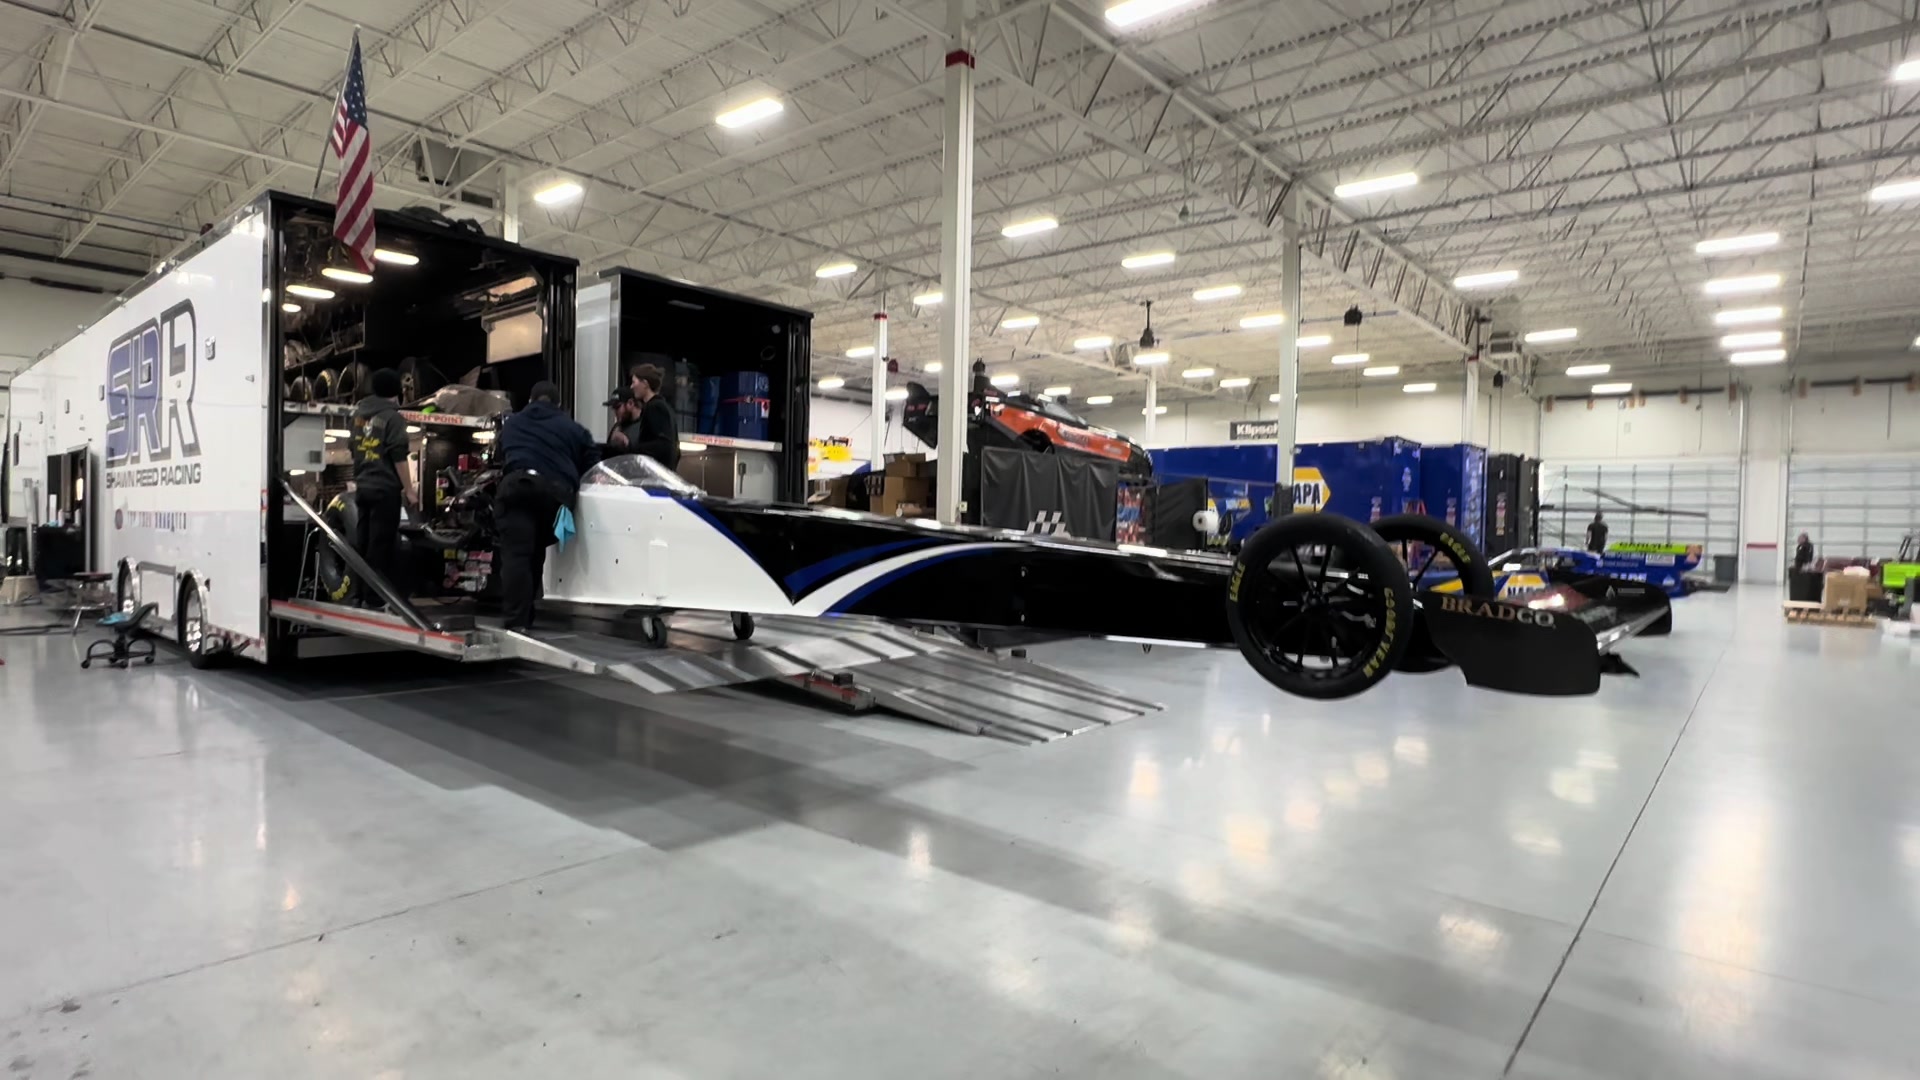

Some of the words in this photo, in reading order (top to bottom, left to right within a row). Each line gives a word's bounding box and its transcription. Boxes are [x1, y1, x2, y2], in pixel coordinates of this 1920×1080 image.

[106, 470, 135, 489] SHAWN
[136, 467, 158, 487] REED
[160, 463, 201, 486] RACING
[1292, 483, 1321, 505] APA
